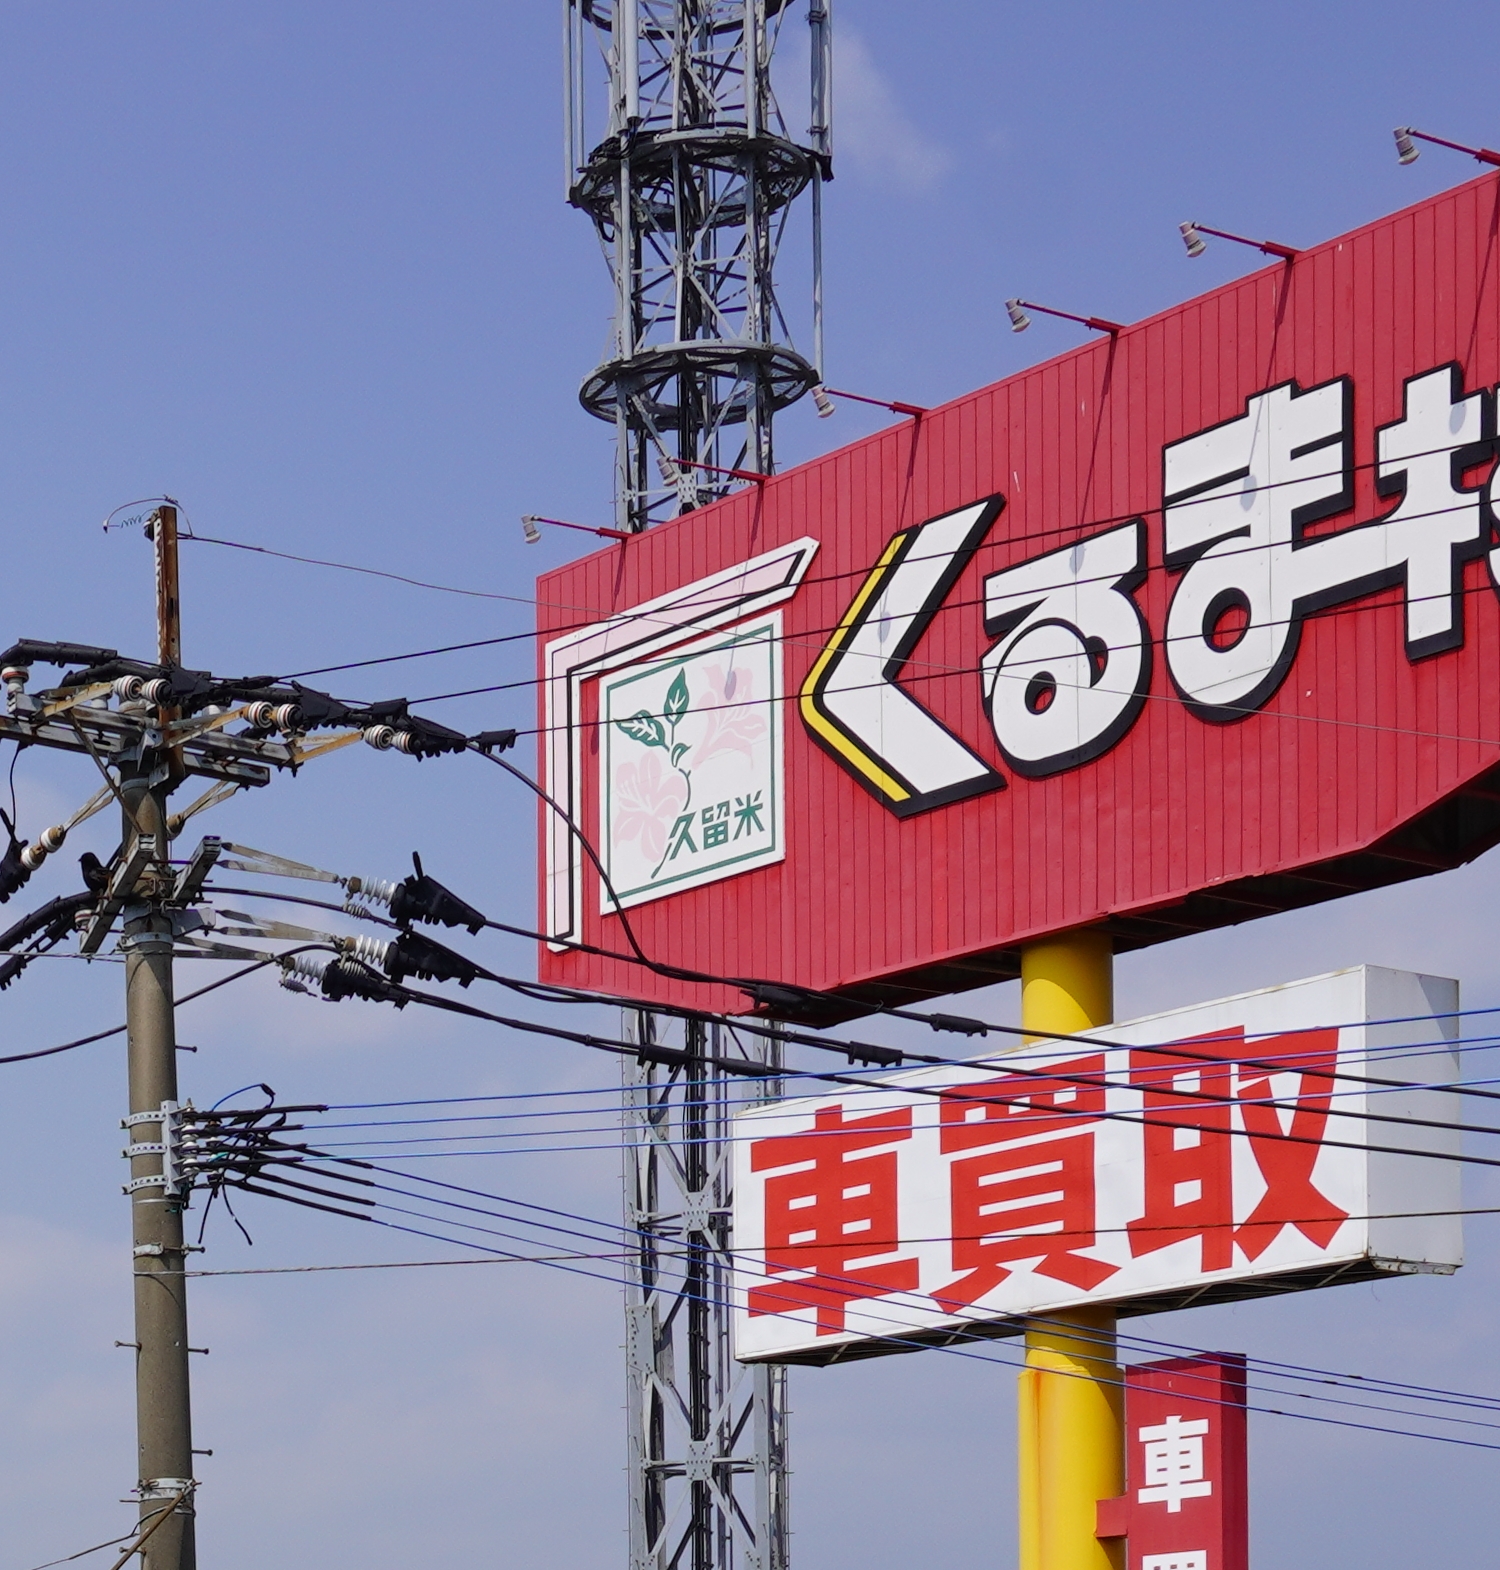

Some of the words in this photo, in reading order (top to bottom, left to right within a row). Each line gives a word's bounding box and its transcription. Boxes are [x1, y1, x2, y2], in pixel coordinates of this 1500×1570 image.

[652, 789, 767, 878] 久留米
[748, 1025, 1350, 1336] 車買取
